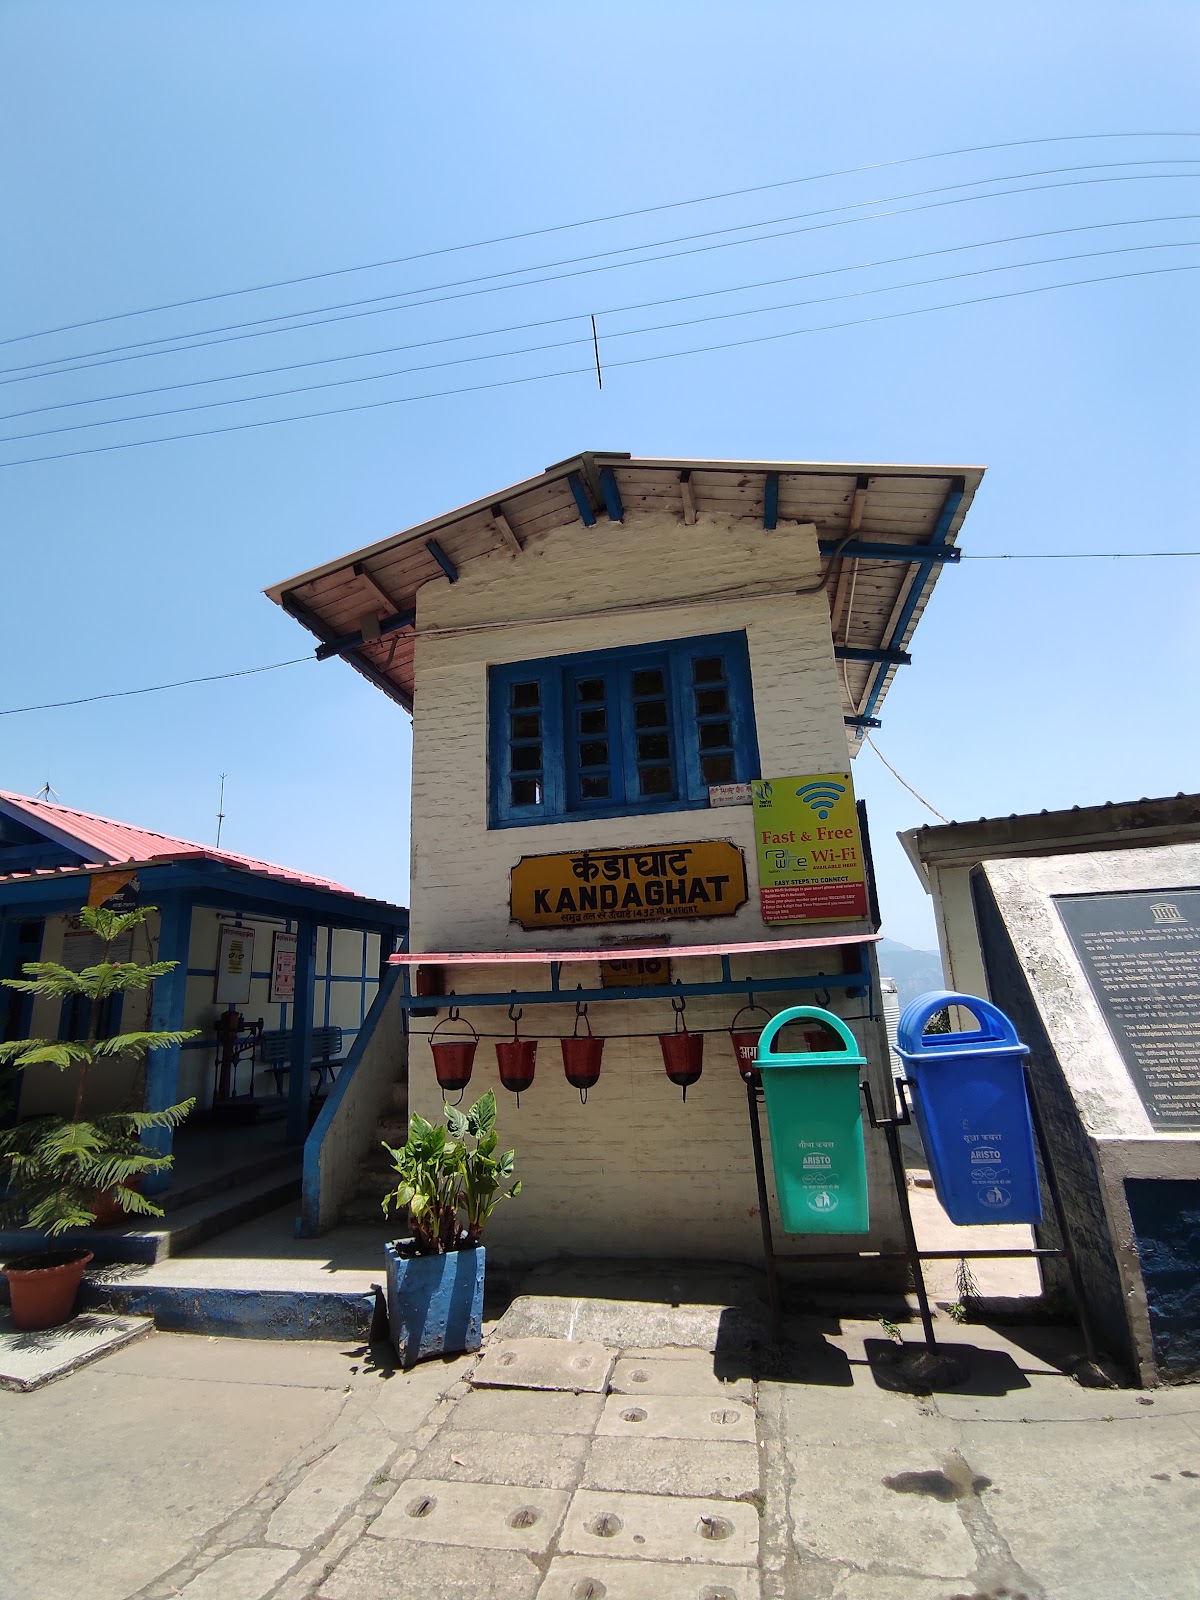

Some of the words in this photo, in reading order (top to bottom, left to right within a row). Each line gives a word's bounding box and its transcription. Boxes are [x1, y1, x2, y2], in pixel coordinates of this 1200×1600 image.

[761, 831, 796, 844] Fast
[801, 832, 812, 841] &
[816, 827, 853, 841] Free
[811, 847, 857, 863] Wi-Fi
[569, 849, 693, 883] कंडाघाट
[534, 875, 730, 914] KANDAGHAT
[583, 911, 596, 921] तल
[597, 909, 607, 920] से
[633, 909, 655, 919] 1432
[739, 1046, 758, 1060] आग
[803, 1156, 831, 1165] ARISTO
[971, 1150, 1001, 1159] ARISTO
